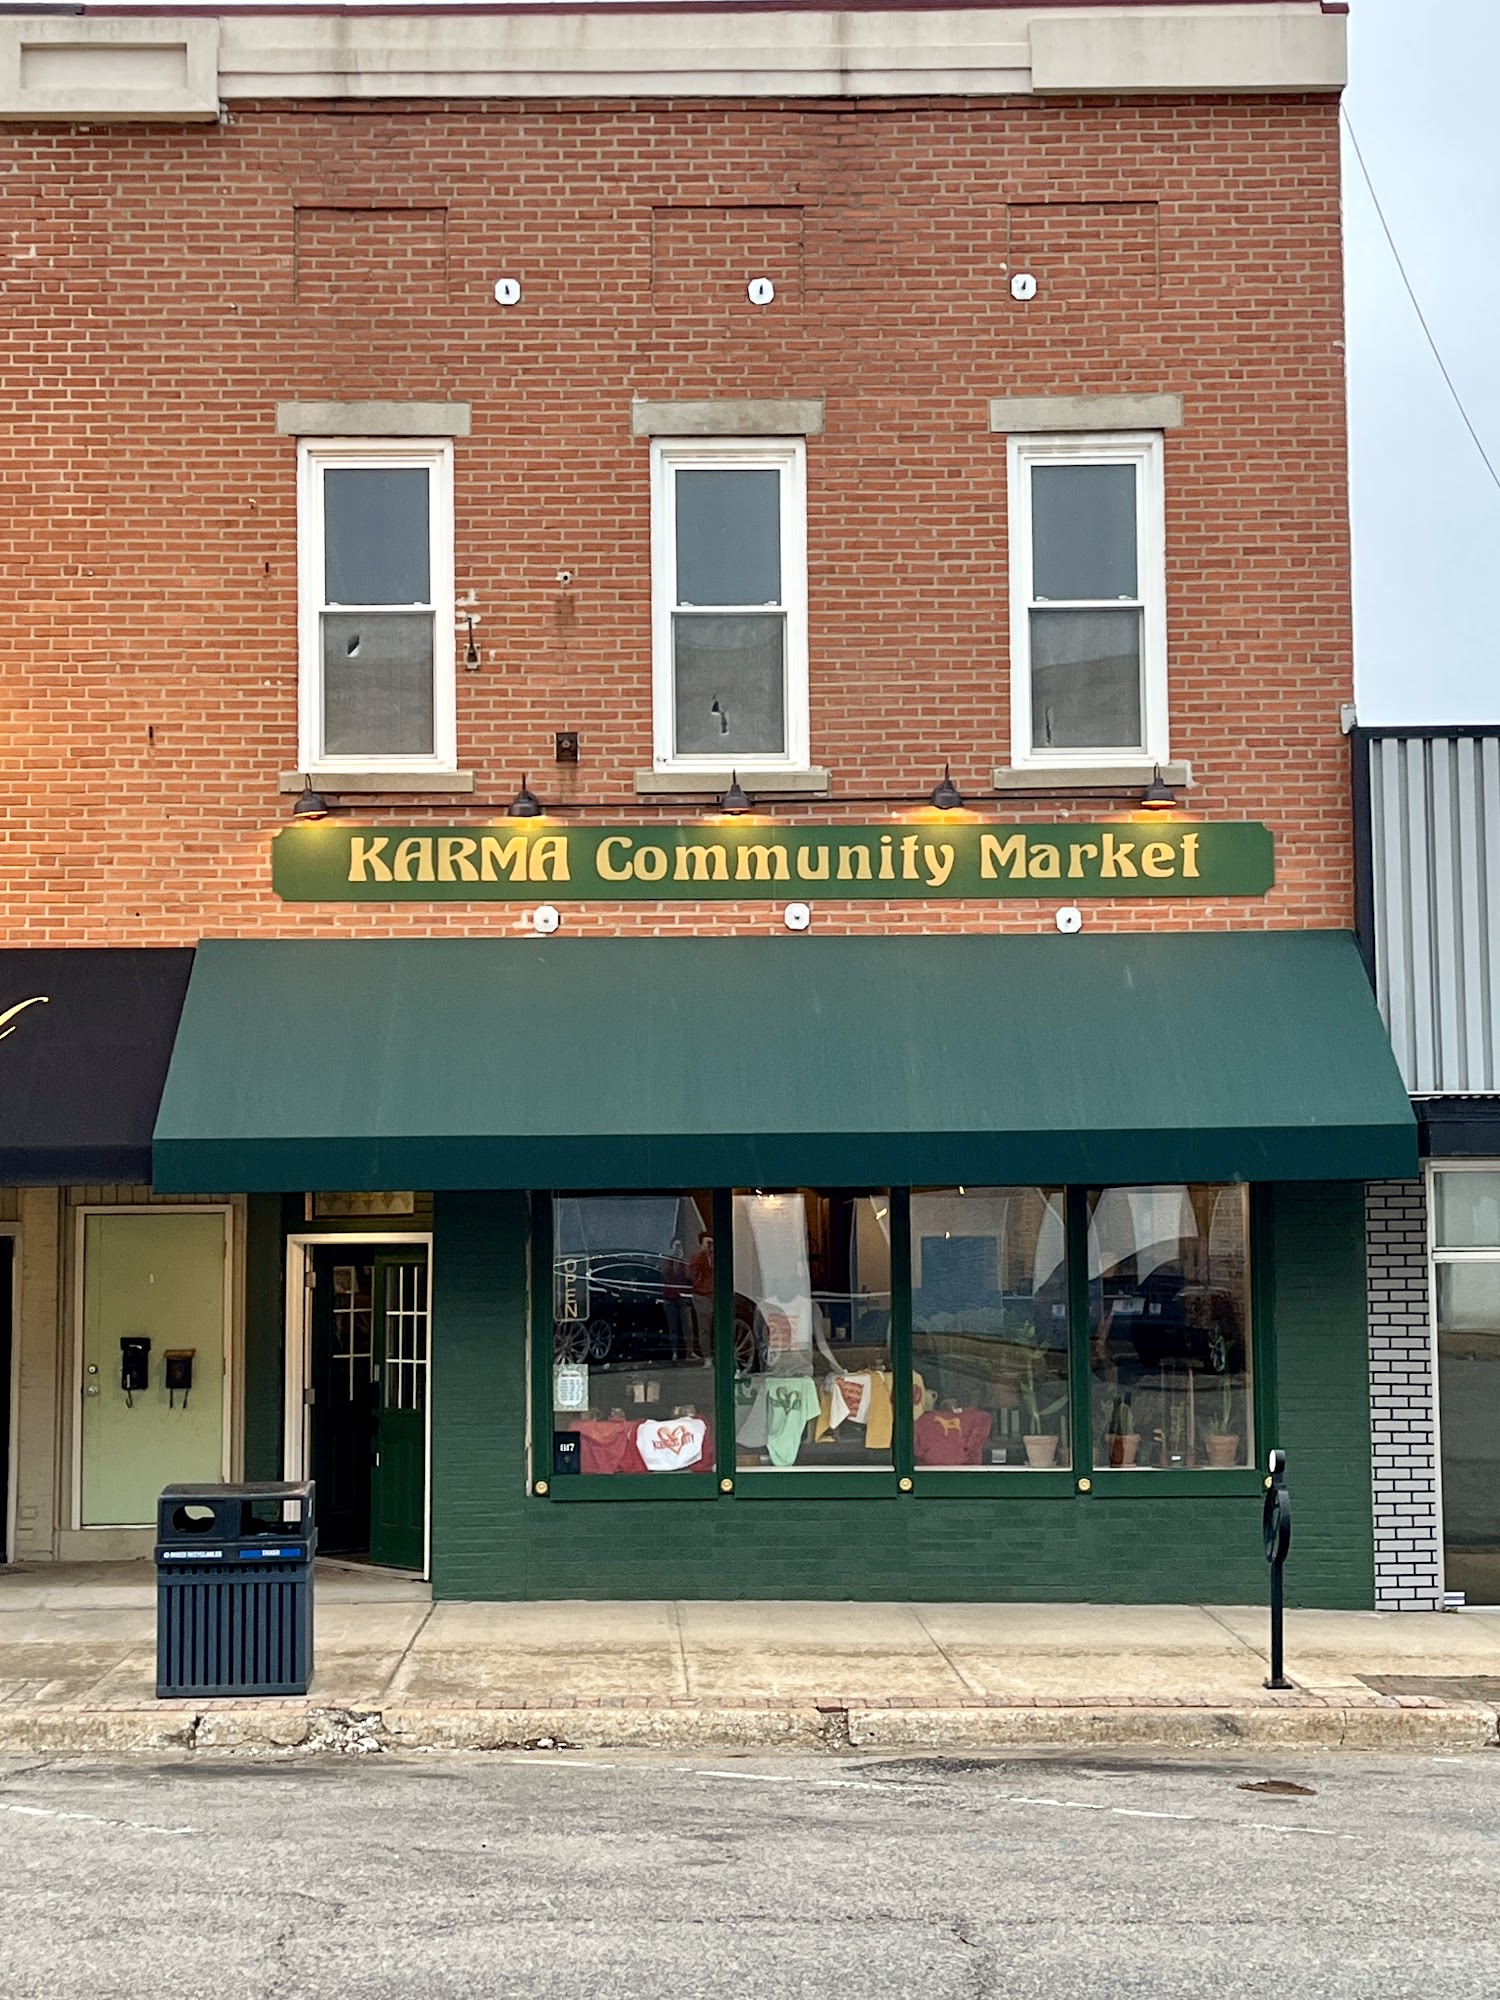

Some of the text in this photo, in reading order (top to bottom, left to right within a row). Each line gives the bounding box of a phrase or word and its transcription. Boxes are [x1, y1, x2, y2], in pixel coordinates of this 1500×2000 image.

[347, 832, 1200, 887] KARMA Community Market
[562, 1258, 578, 1318] OPEN
